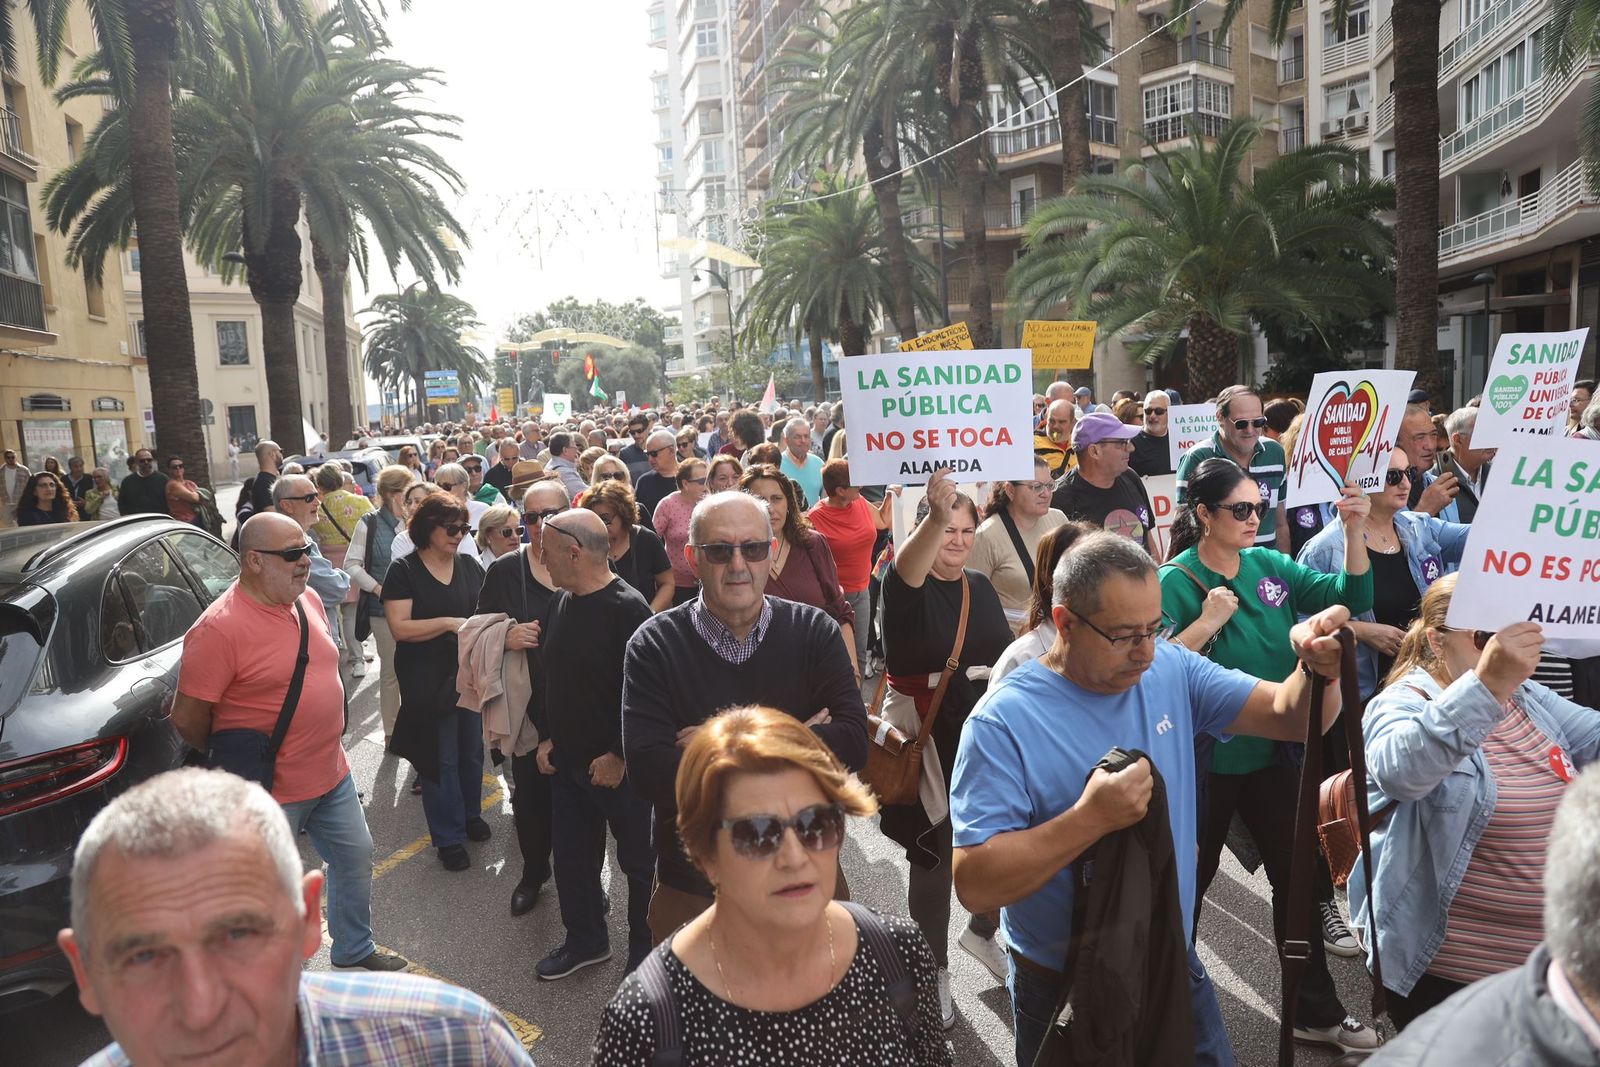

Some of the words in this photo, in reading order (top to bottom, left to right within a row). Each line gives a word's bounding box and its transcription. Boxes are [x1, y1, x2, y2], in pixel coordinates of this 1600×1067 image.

[1507, 339, 1580, 365] SANIDAD
[857, 368, 890, 390] LA
[897, 363, 1022, 388] SANIDAD
[881, 391, 993, 418] PÚBLICA
[1323, 402, 1367, 425] SANIDAD
[1522, 406, 1544, 420] DE
[1174, 416, 1186, 424] LA
[1188, 415, 1217, 424] SALUD
[1181, 425, 1192, 433] ES
[1194, 425, 1209, 433] UN
[865, 430, 906, 451] NO
[912, 429, 940, 450] SE
[946, 427, 1013, 447] TOCA
[1178, 440, 1196, 449] NO
[1328, 448, 1336, 457] DE
[899, 458, 983, 475] ALAMEDA
[1511, 456, 1554, 489] LA
[1529, 498, 1600, 540] PÚB
[1482, 549, 1532, 577] NO
[1540, 555, 1573, 581] ES
